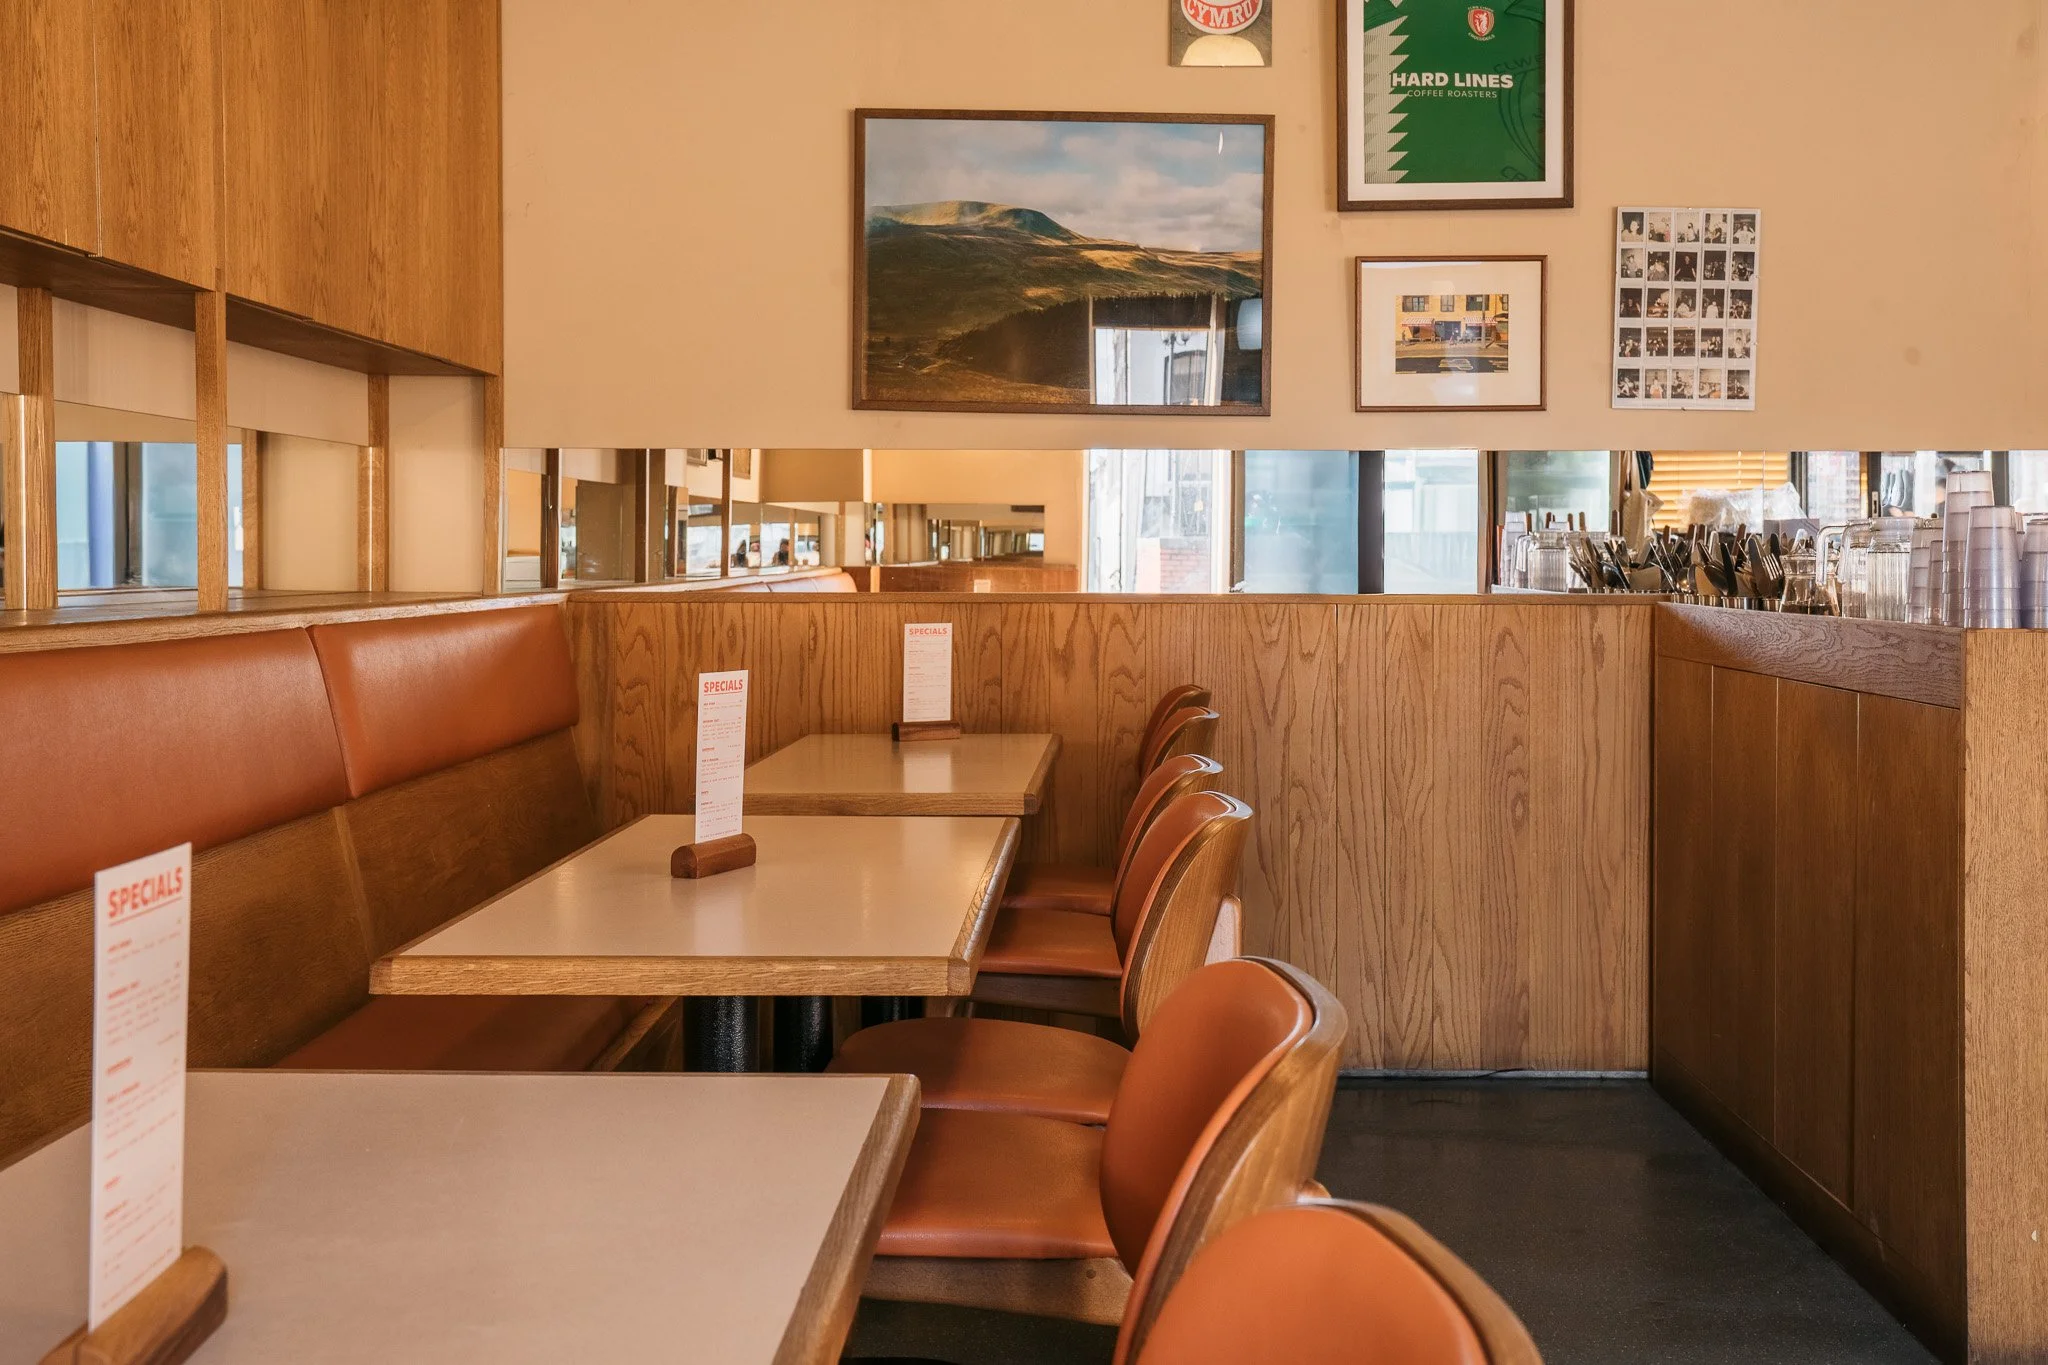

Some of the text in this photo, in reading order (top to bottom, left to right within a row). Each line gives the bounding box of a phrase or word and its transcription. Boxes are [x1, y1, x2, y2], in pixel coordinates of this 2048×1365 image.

[1187, 0, 1253, 28] CYMRU
[1392, 72, 1514, 88] HARD LINES
[1407, 89, 1498, 98] COFFEE ROASTERS
[703, 679, 744, 693] SPECIALS
[107, 866, 183, 918] SPECIALS
